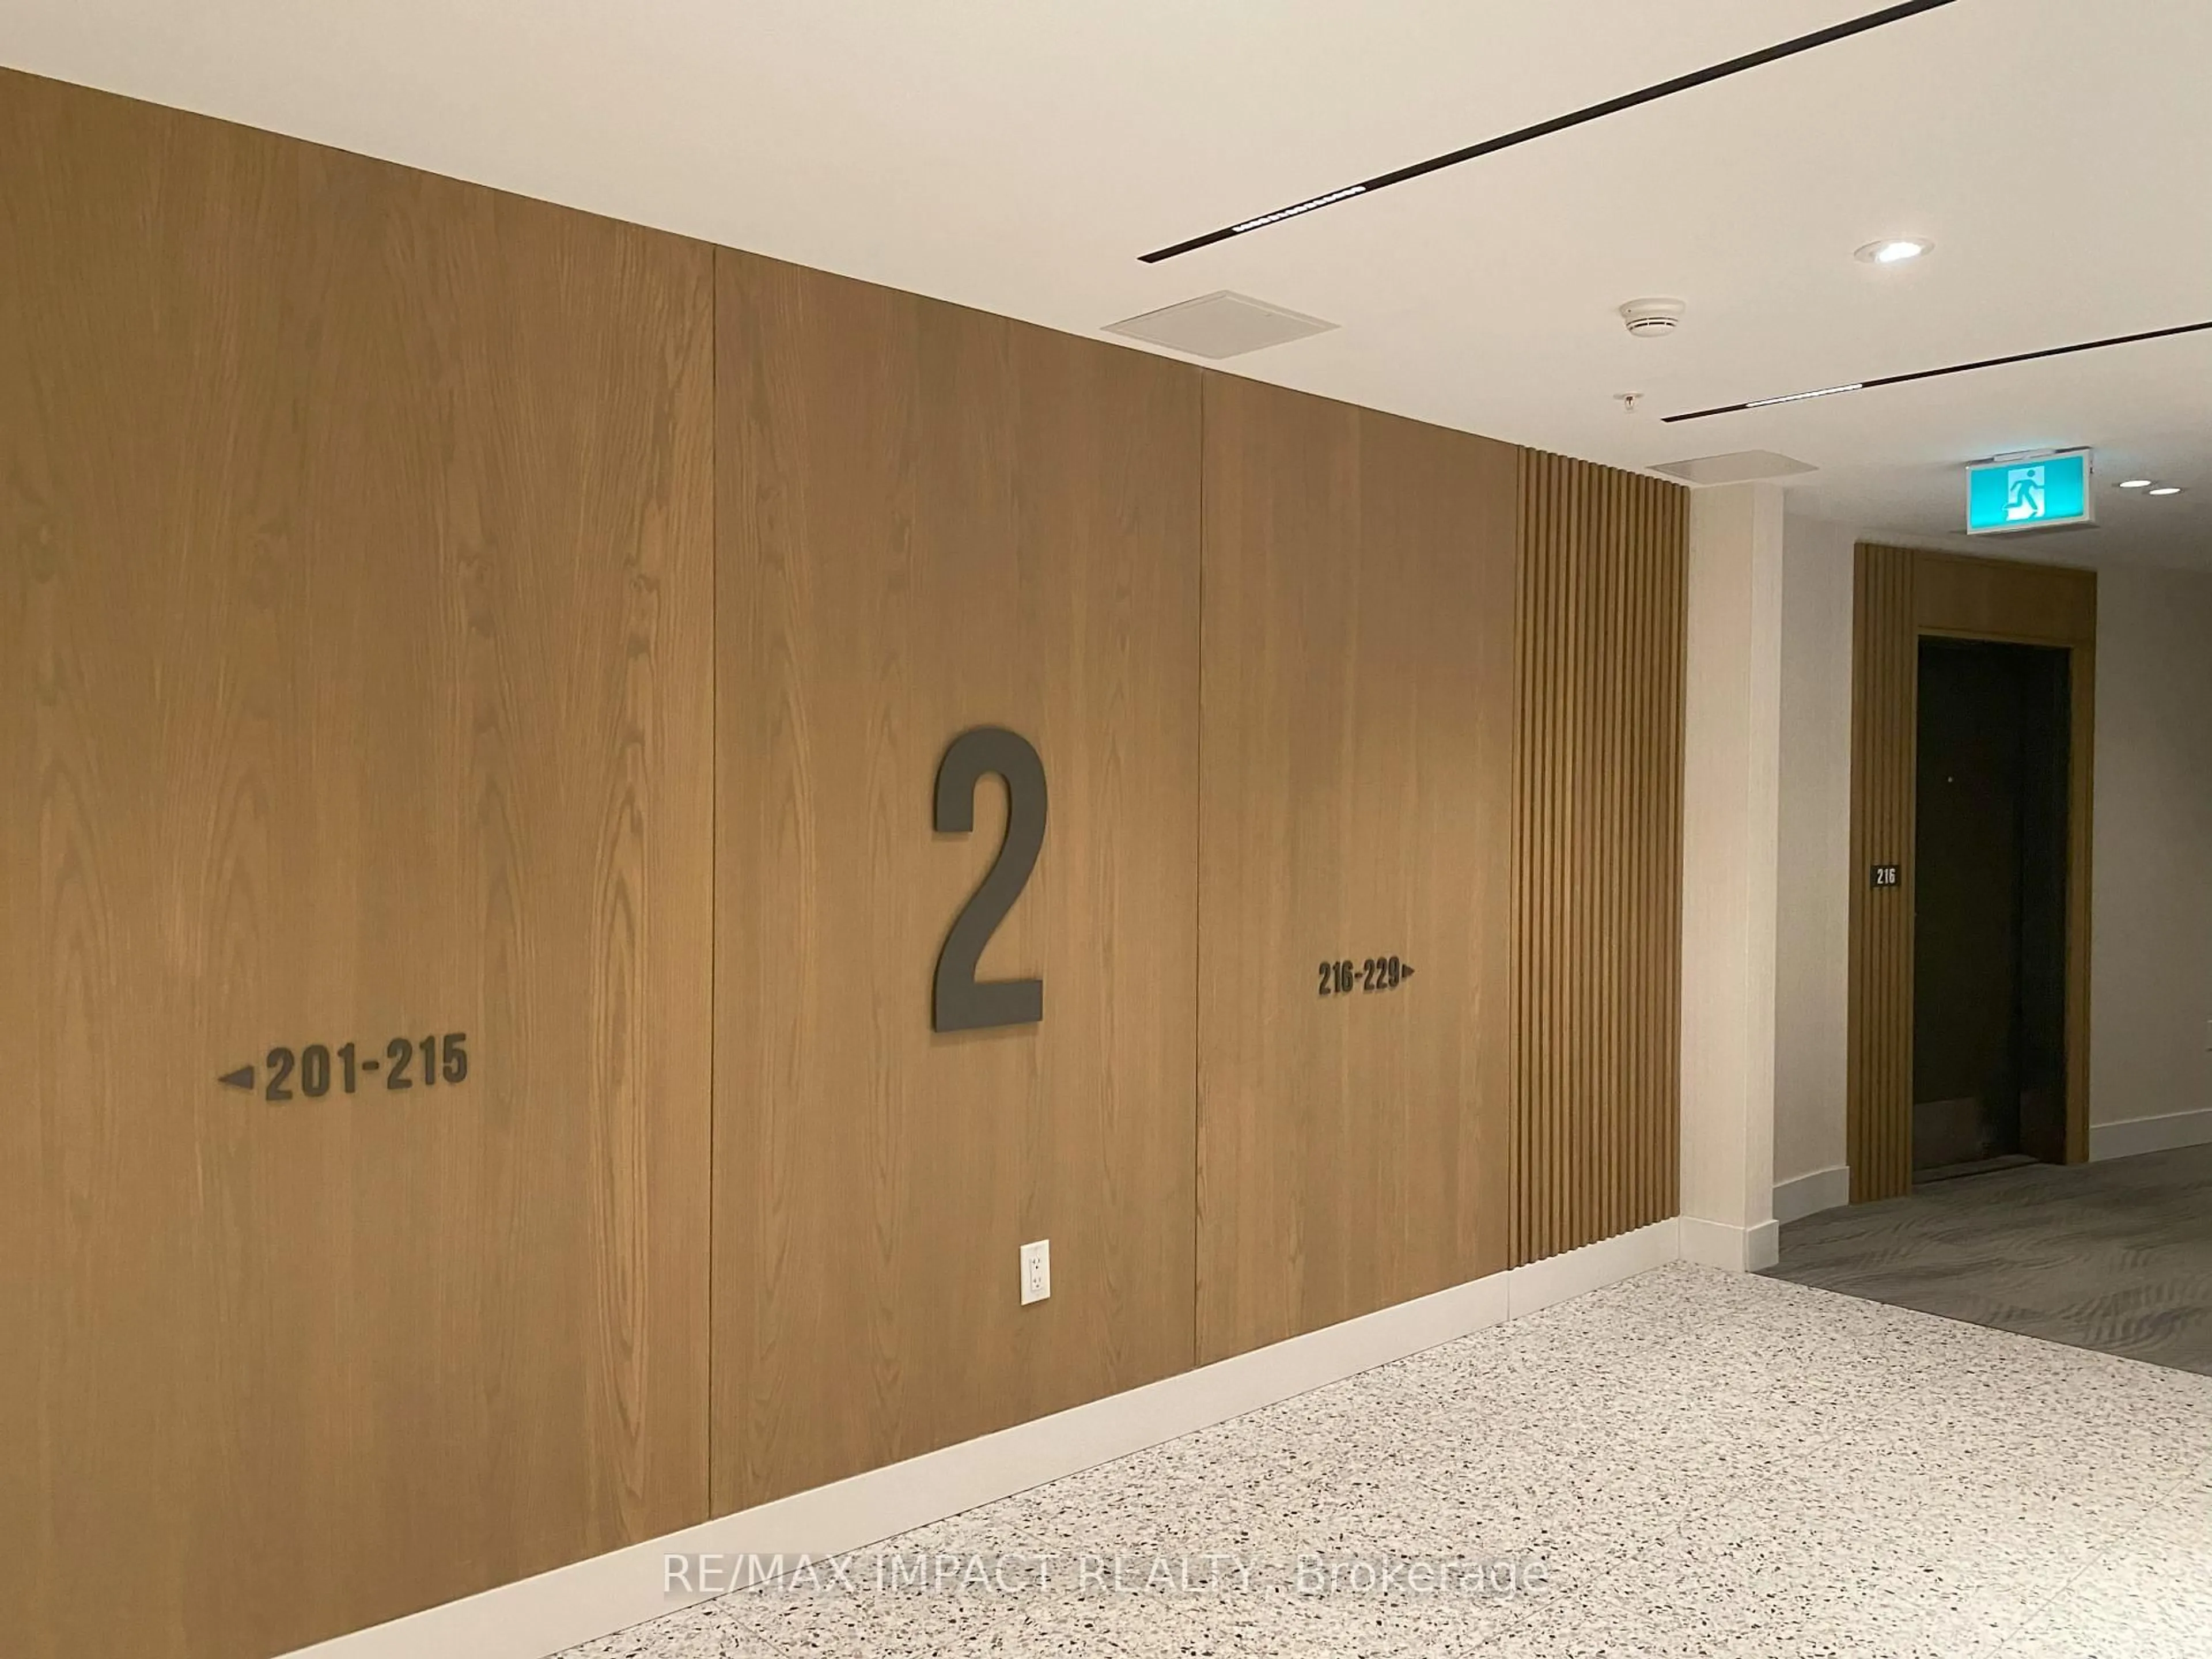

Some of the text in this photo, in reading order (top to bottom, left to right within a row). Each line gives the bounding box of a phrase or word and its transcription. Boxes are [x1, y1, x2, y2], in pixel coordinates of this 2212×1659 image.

[933, 726, 1047, 1032] 2
[1877, 868, 1895, 884] 216
[1319, 956, 1400, 995] 216-229
[266, 1033, 468, 1101] 201-215
